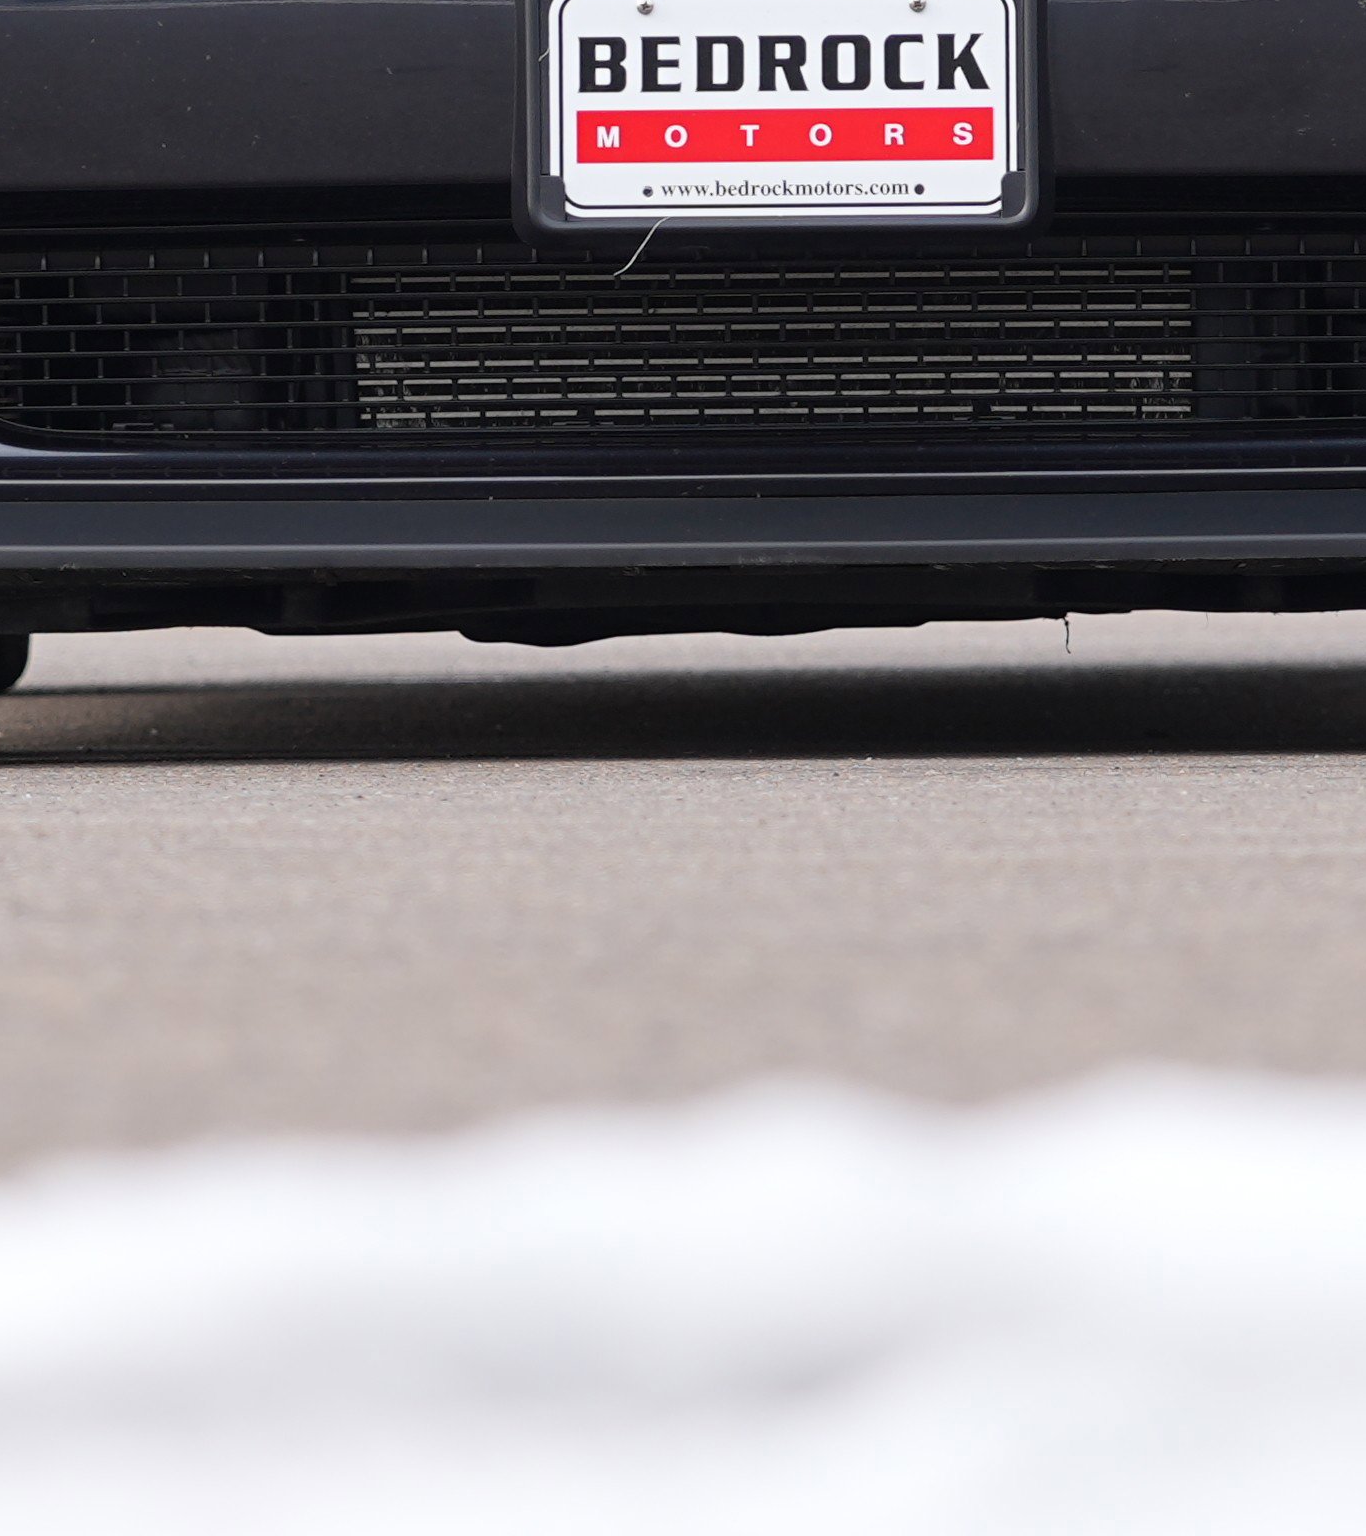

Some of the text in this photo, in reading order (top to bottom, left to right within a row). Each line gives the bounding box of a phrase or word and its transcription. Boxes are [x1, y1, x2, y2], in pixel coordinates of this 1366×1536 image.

[578, 34, 990, 93] BEDROCK
[596, 122, 974, 148] MOTORS
[660, 179, 910, 199] www.bedrockmotors.com
